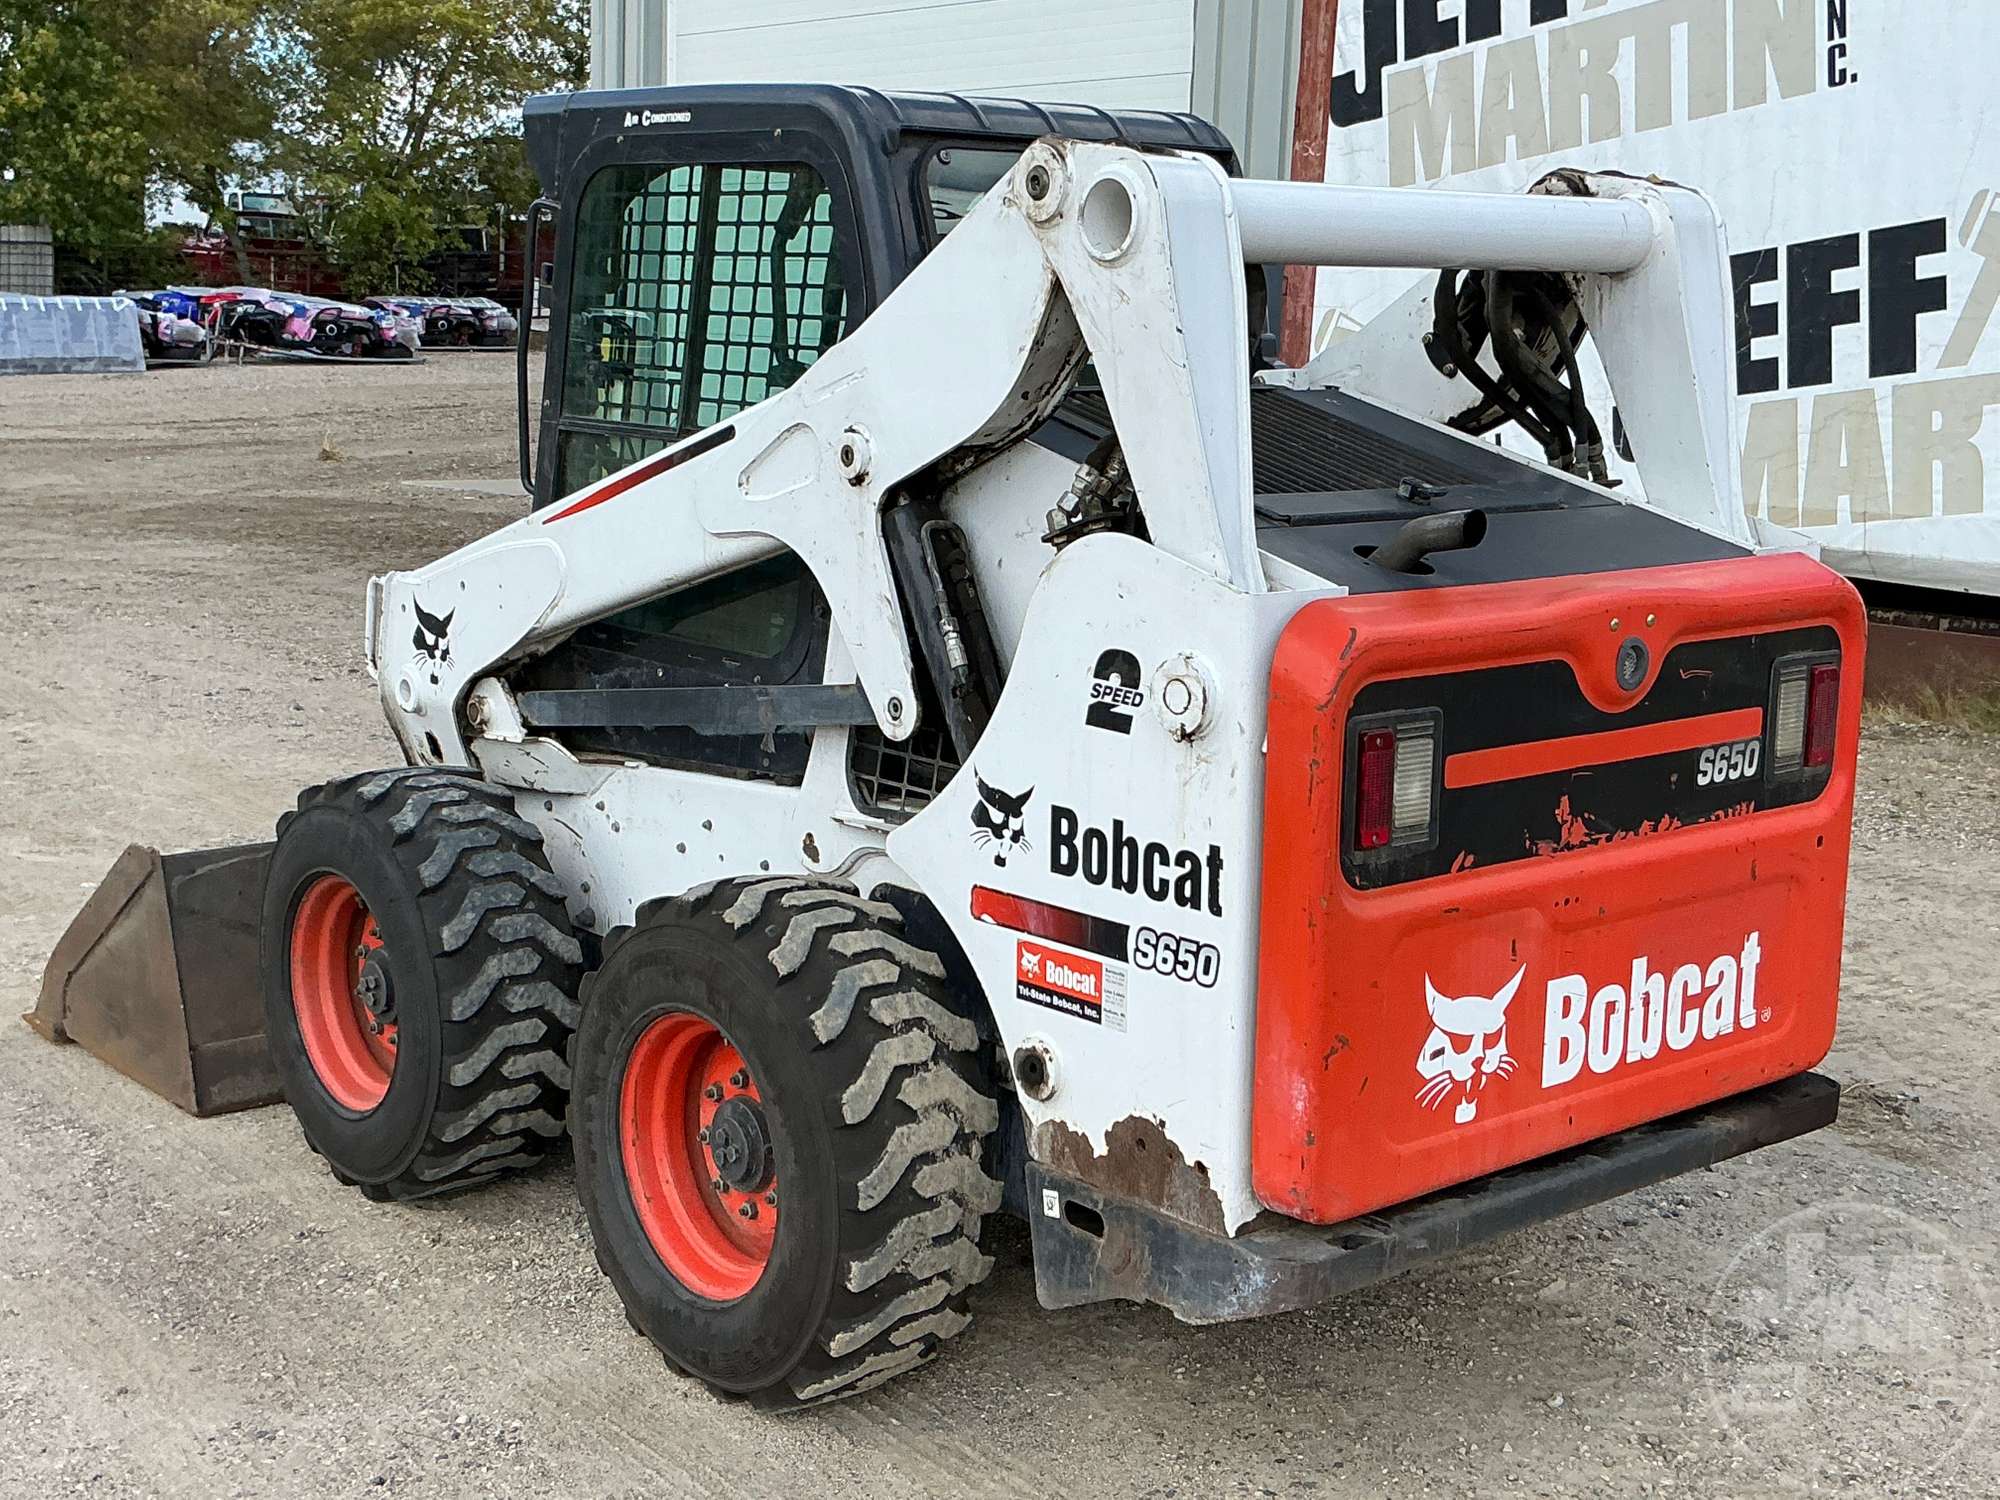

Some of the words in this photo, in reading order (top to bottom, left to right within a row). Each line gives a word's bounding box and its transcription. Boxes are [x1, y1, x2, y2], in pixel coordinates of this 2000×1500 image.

[1387, 0, 1817, 185] MARTIN
[1827, 0, 1858, 88] NC.
[1729, 217, 1947, 395] EFF
[1090, 683, 1144, 707] SPEED
[1697, 740, 1760, 786] S650
[1050, 804, 1224, 918] Bobcat
[1134, 926, 1221, 989] S650
[1541, 930, 1761, 1089] Bobcat
